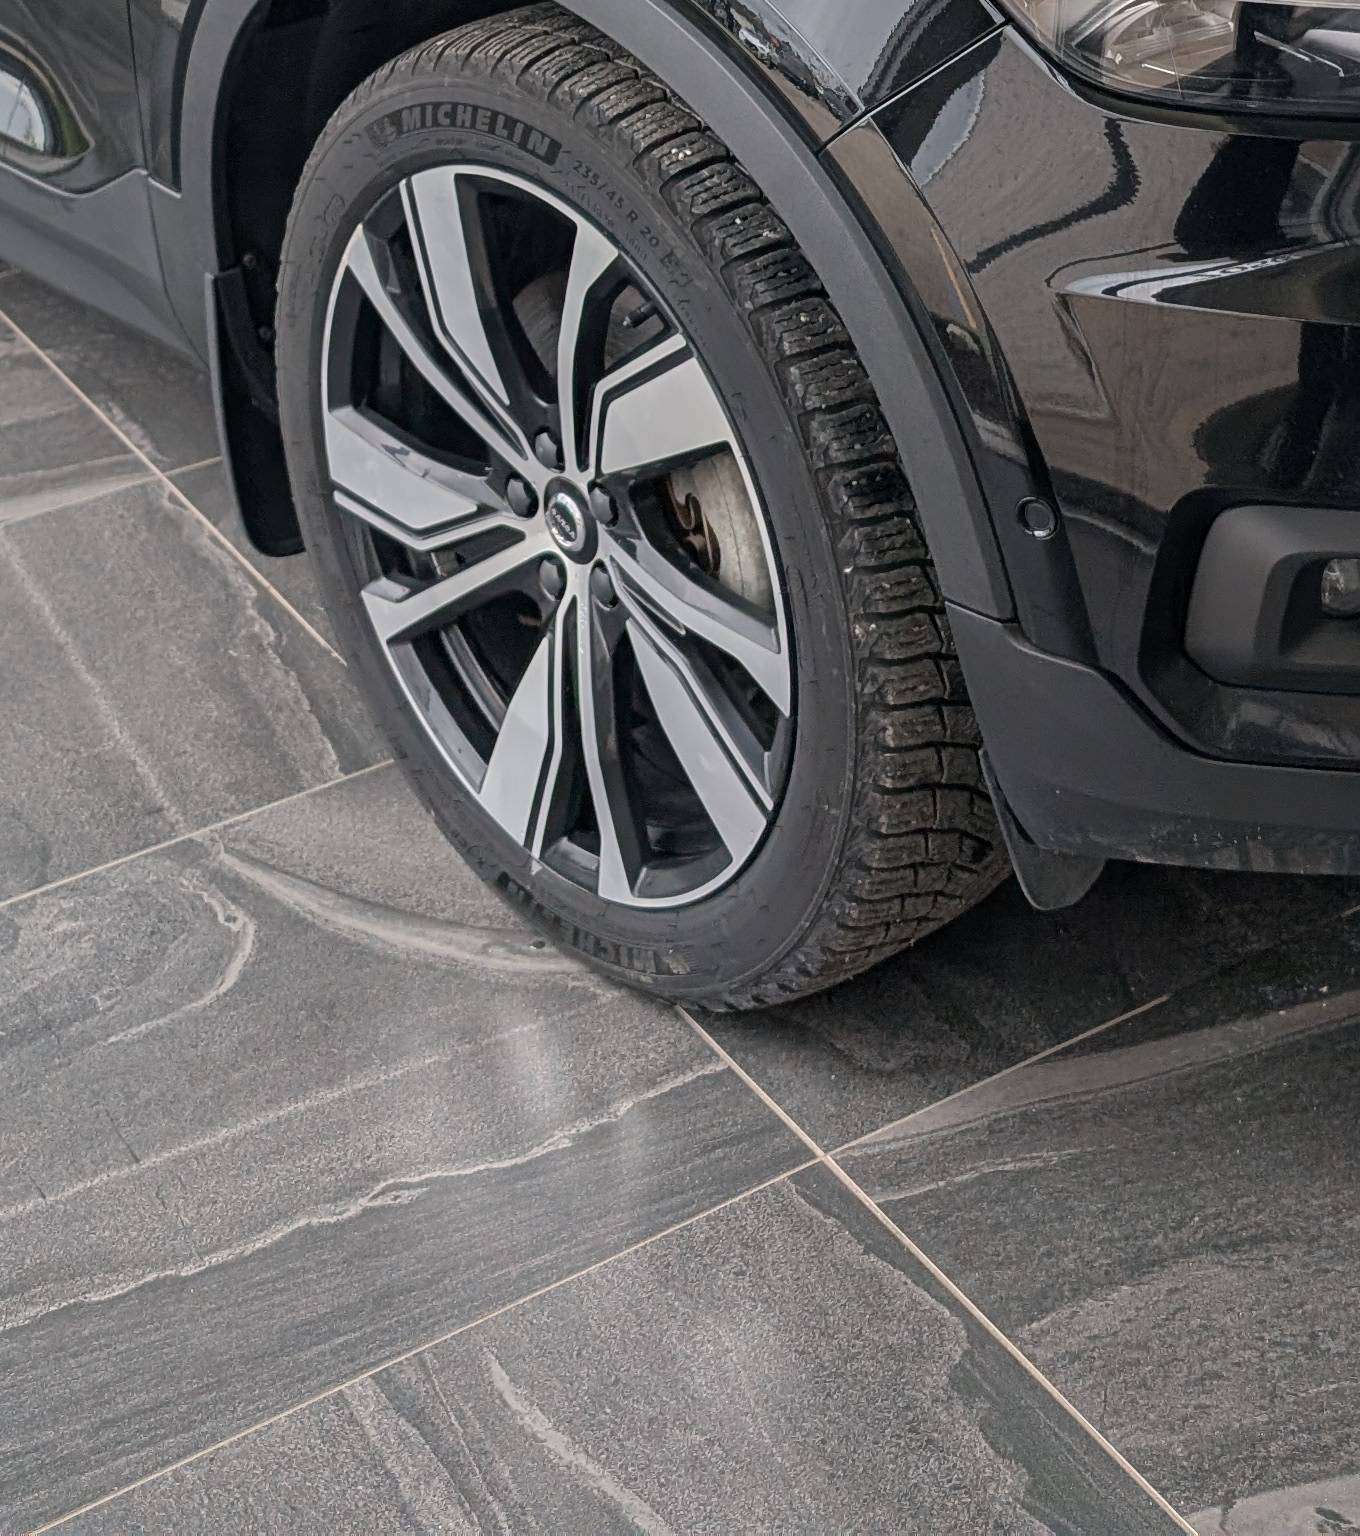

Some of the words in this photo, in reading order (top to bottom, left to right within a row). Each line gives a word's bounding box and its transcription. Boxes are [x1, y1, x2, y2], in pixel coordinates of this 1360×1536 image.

[400, 105, 552, 156] MICHELIN
[573, 160, 624, 209] 235/45
[626, 209, 639, 224] R
[640, 226, 660, 248] 20
